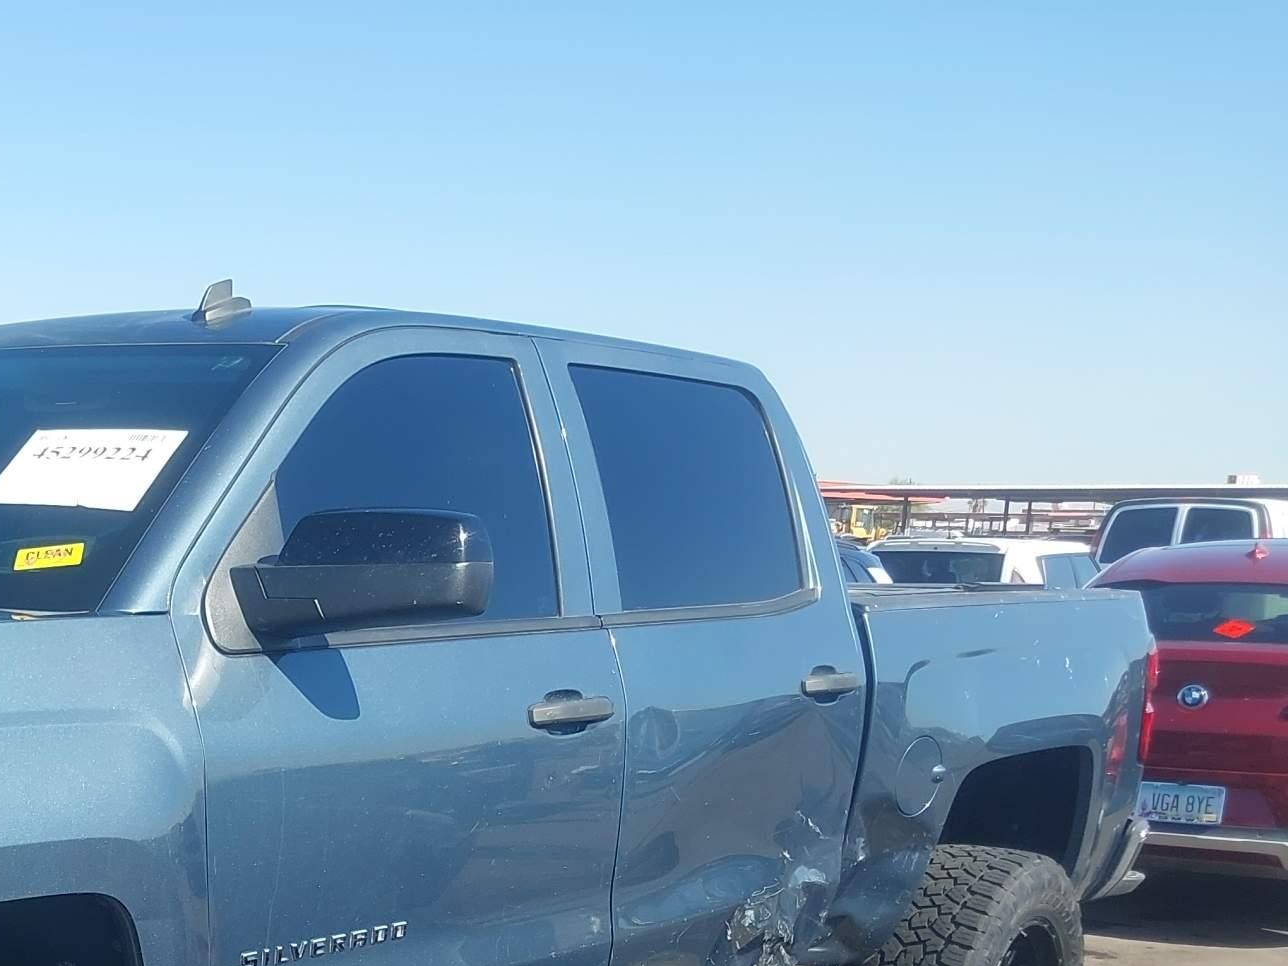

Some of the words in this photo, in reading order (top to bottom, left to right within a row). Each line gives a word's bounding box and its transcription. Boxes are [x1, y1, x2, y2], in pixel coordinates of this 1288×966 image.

[32, 446, 153, 461] 45299224
[25, 547, 74, 561] CLEAN
[1151, 792, 1179, 813] VGA
[1185, 795, 1215, 815] 8YE
